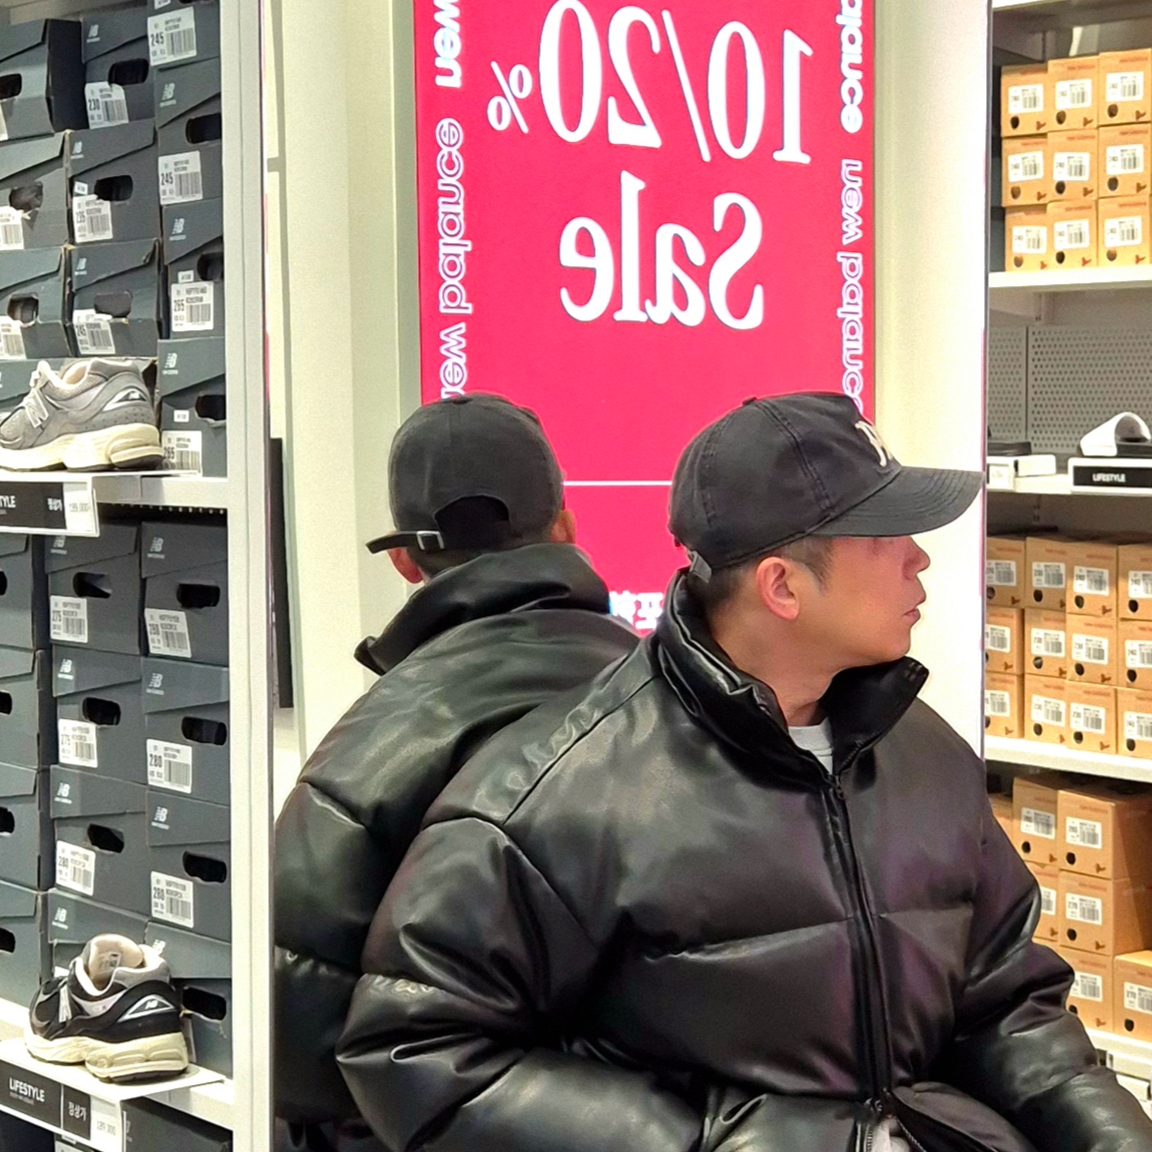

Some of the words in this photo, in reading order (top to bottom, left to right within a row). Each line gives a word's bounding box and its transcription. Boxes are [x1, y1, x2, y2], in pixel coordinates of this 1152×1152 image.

[150, 31, 165, 47] 245
[161, 171, 174, 186] 245
[1092, 473, 1126, 483] LIFESTYLE
[9, 1077, 45, 1102] LIFESTYLE
[68, 1101, 87, 1121] 정상가
